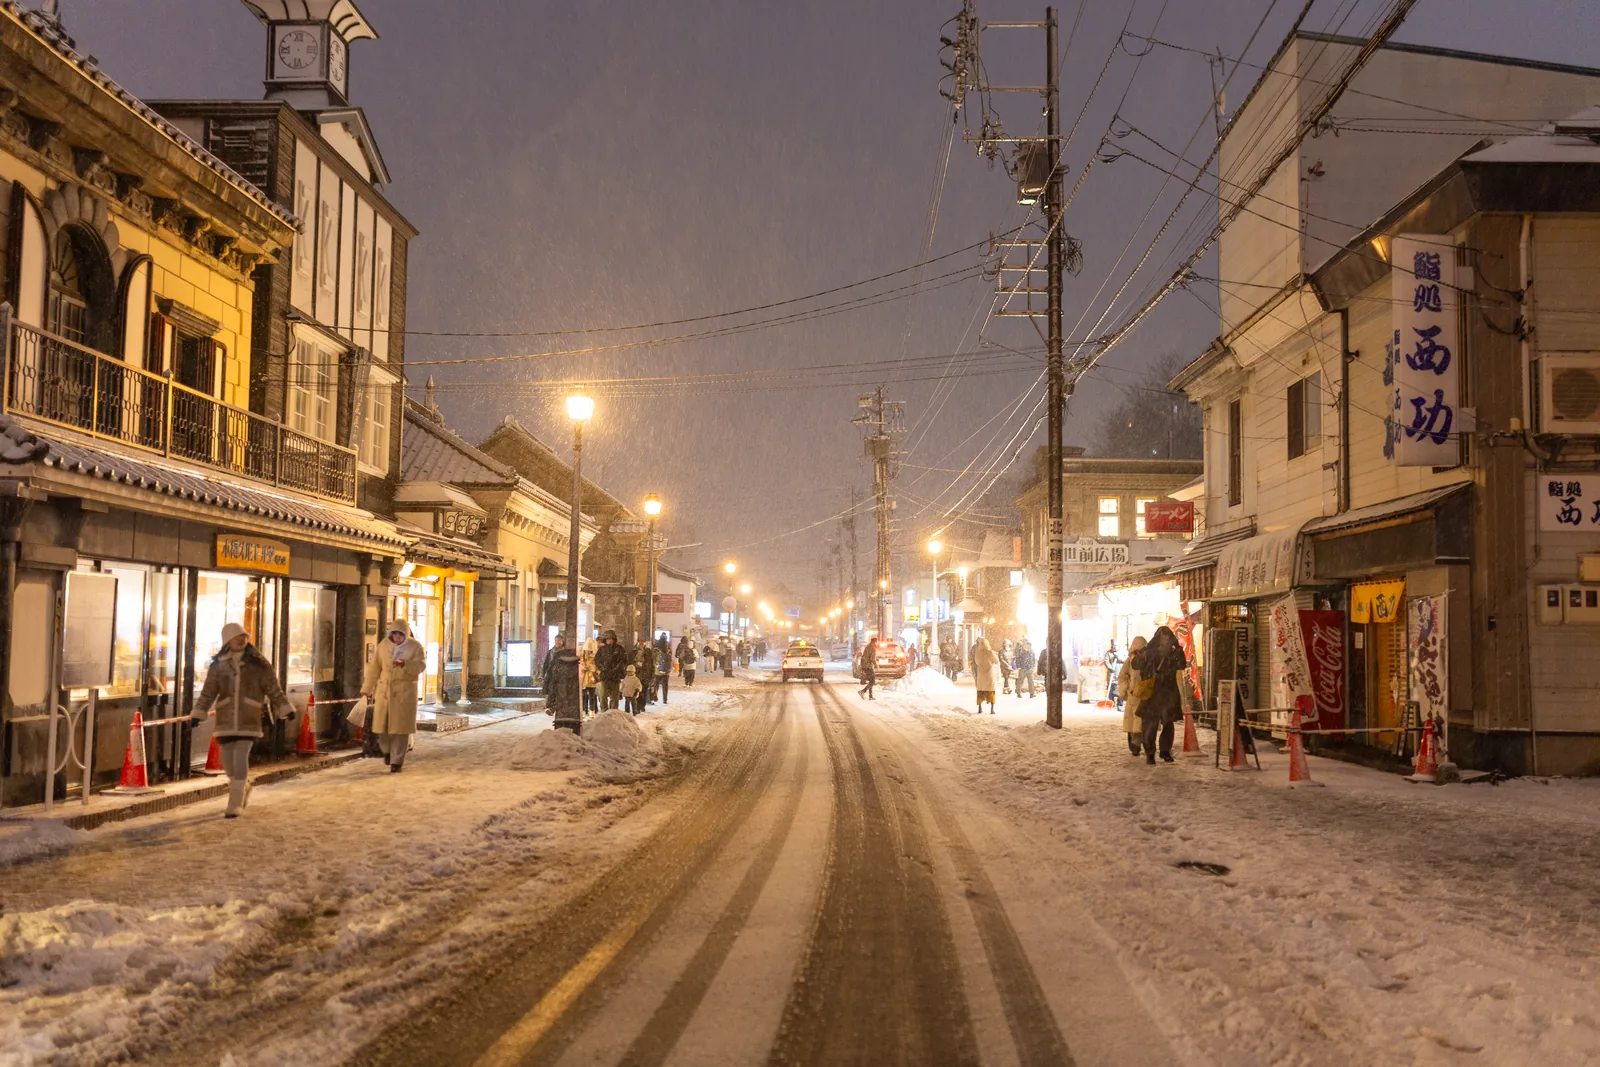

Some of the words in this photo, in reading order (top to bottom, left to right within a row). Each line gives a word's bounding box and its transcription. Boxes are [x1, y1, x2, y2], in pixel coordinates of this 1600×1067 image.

[1149, 507, 1190, 520] ラーメン
[1064, 546, 1125, 563] 世前広場
[1304, 550, 1313, 580] くすり
